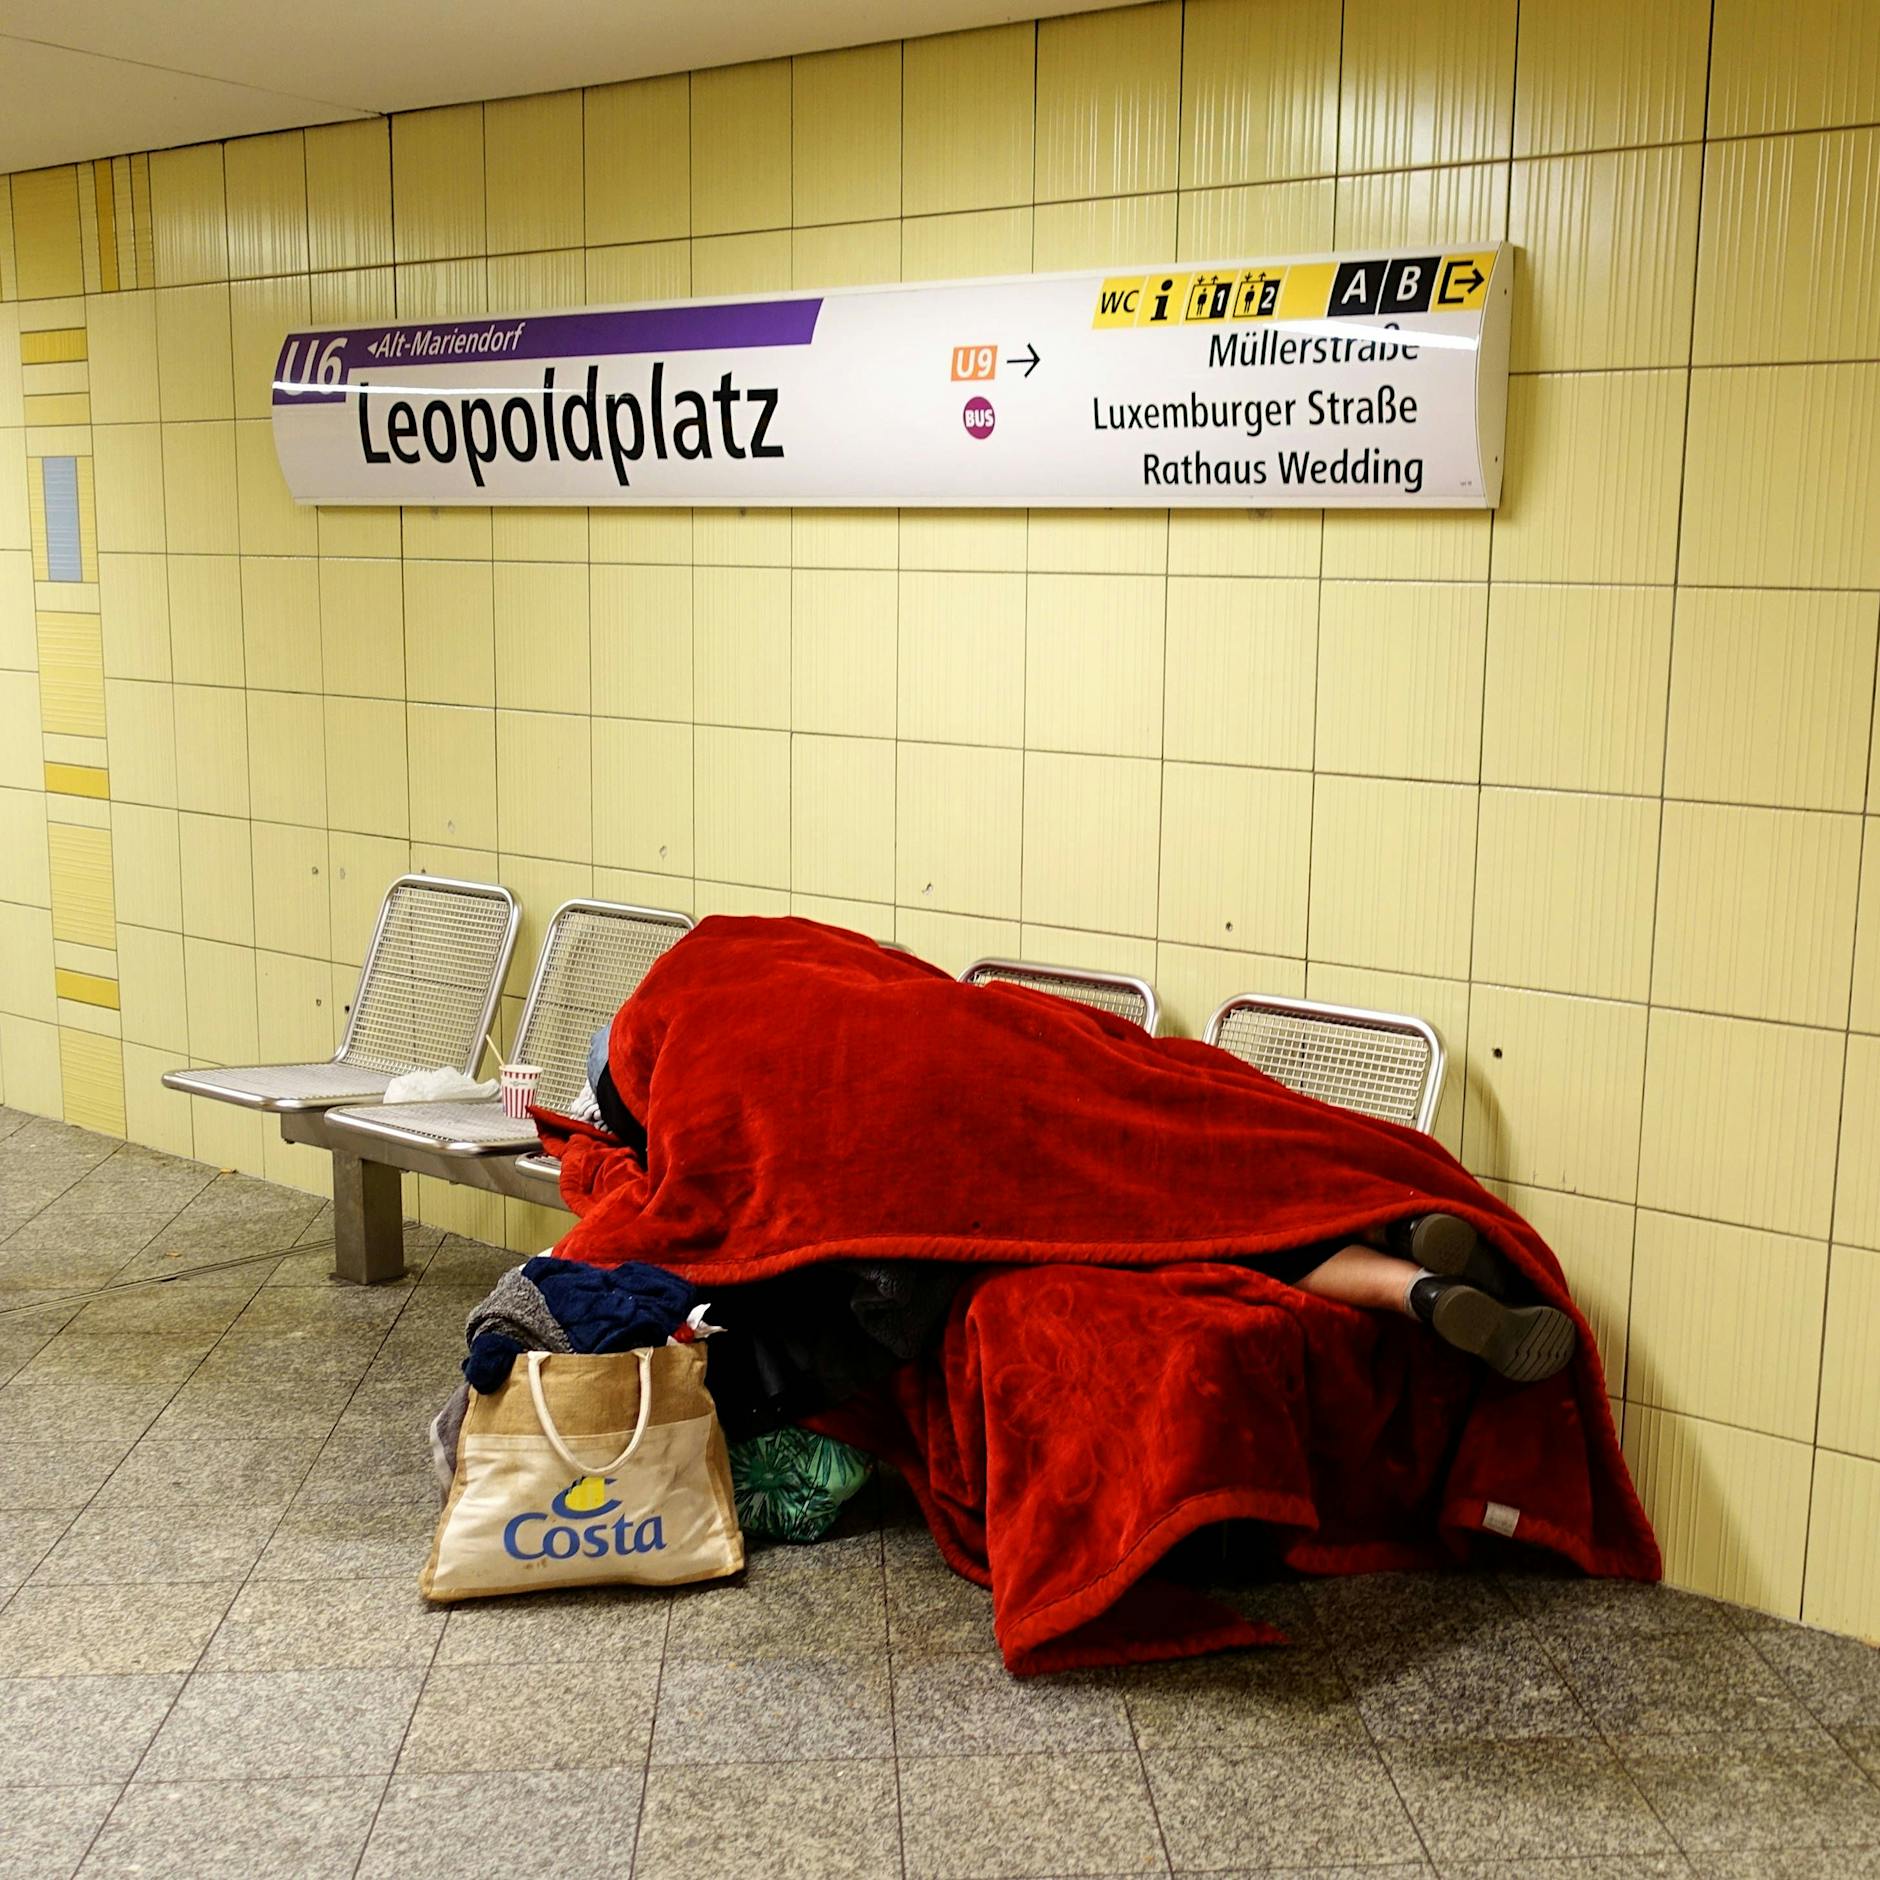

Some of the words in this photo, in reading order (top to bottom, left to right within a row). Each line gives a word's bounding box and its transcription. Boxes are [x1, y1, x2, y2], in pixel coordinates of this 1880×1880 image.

[1100, 289, 1139, 314] WC
[1216, 288, 1226, 311] 1
[1261, 286, 1275, 309] 2
[1341, 268, 1367, 304] A
[1396, 265, 1422, 301] B
[375, 322, 526, 358] Alt-Mariendorf
[956, 347, 993, 378] U9
[281, 336, 348, 396] U6
[357, 362, 785, 487] Leopoldplatz
[964, 408, 994, 428] BUS
[1093, 394, 1296, 437] Luxemburger
[1308, 385, 1418, 425] Straße
[1142, 452, 1267, 486] Rathaus
[1277, 448, 1425, 493] Wedding
[503, 1511, 667, 1561] Costa
